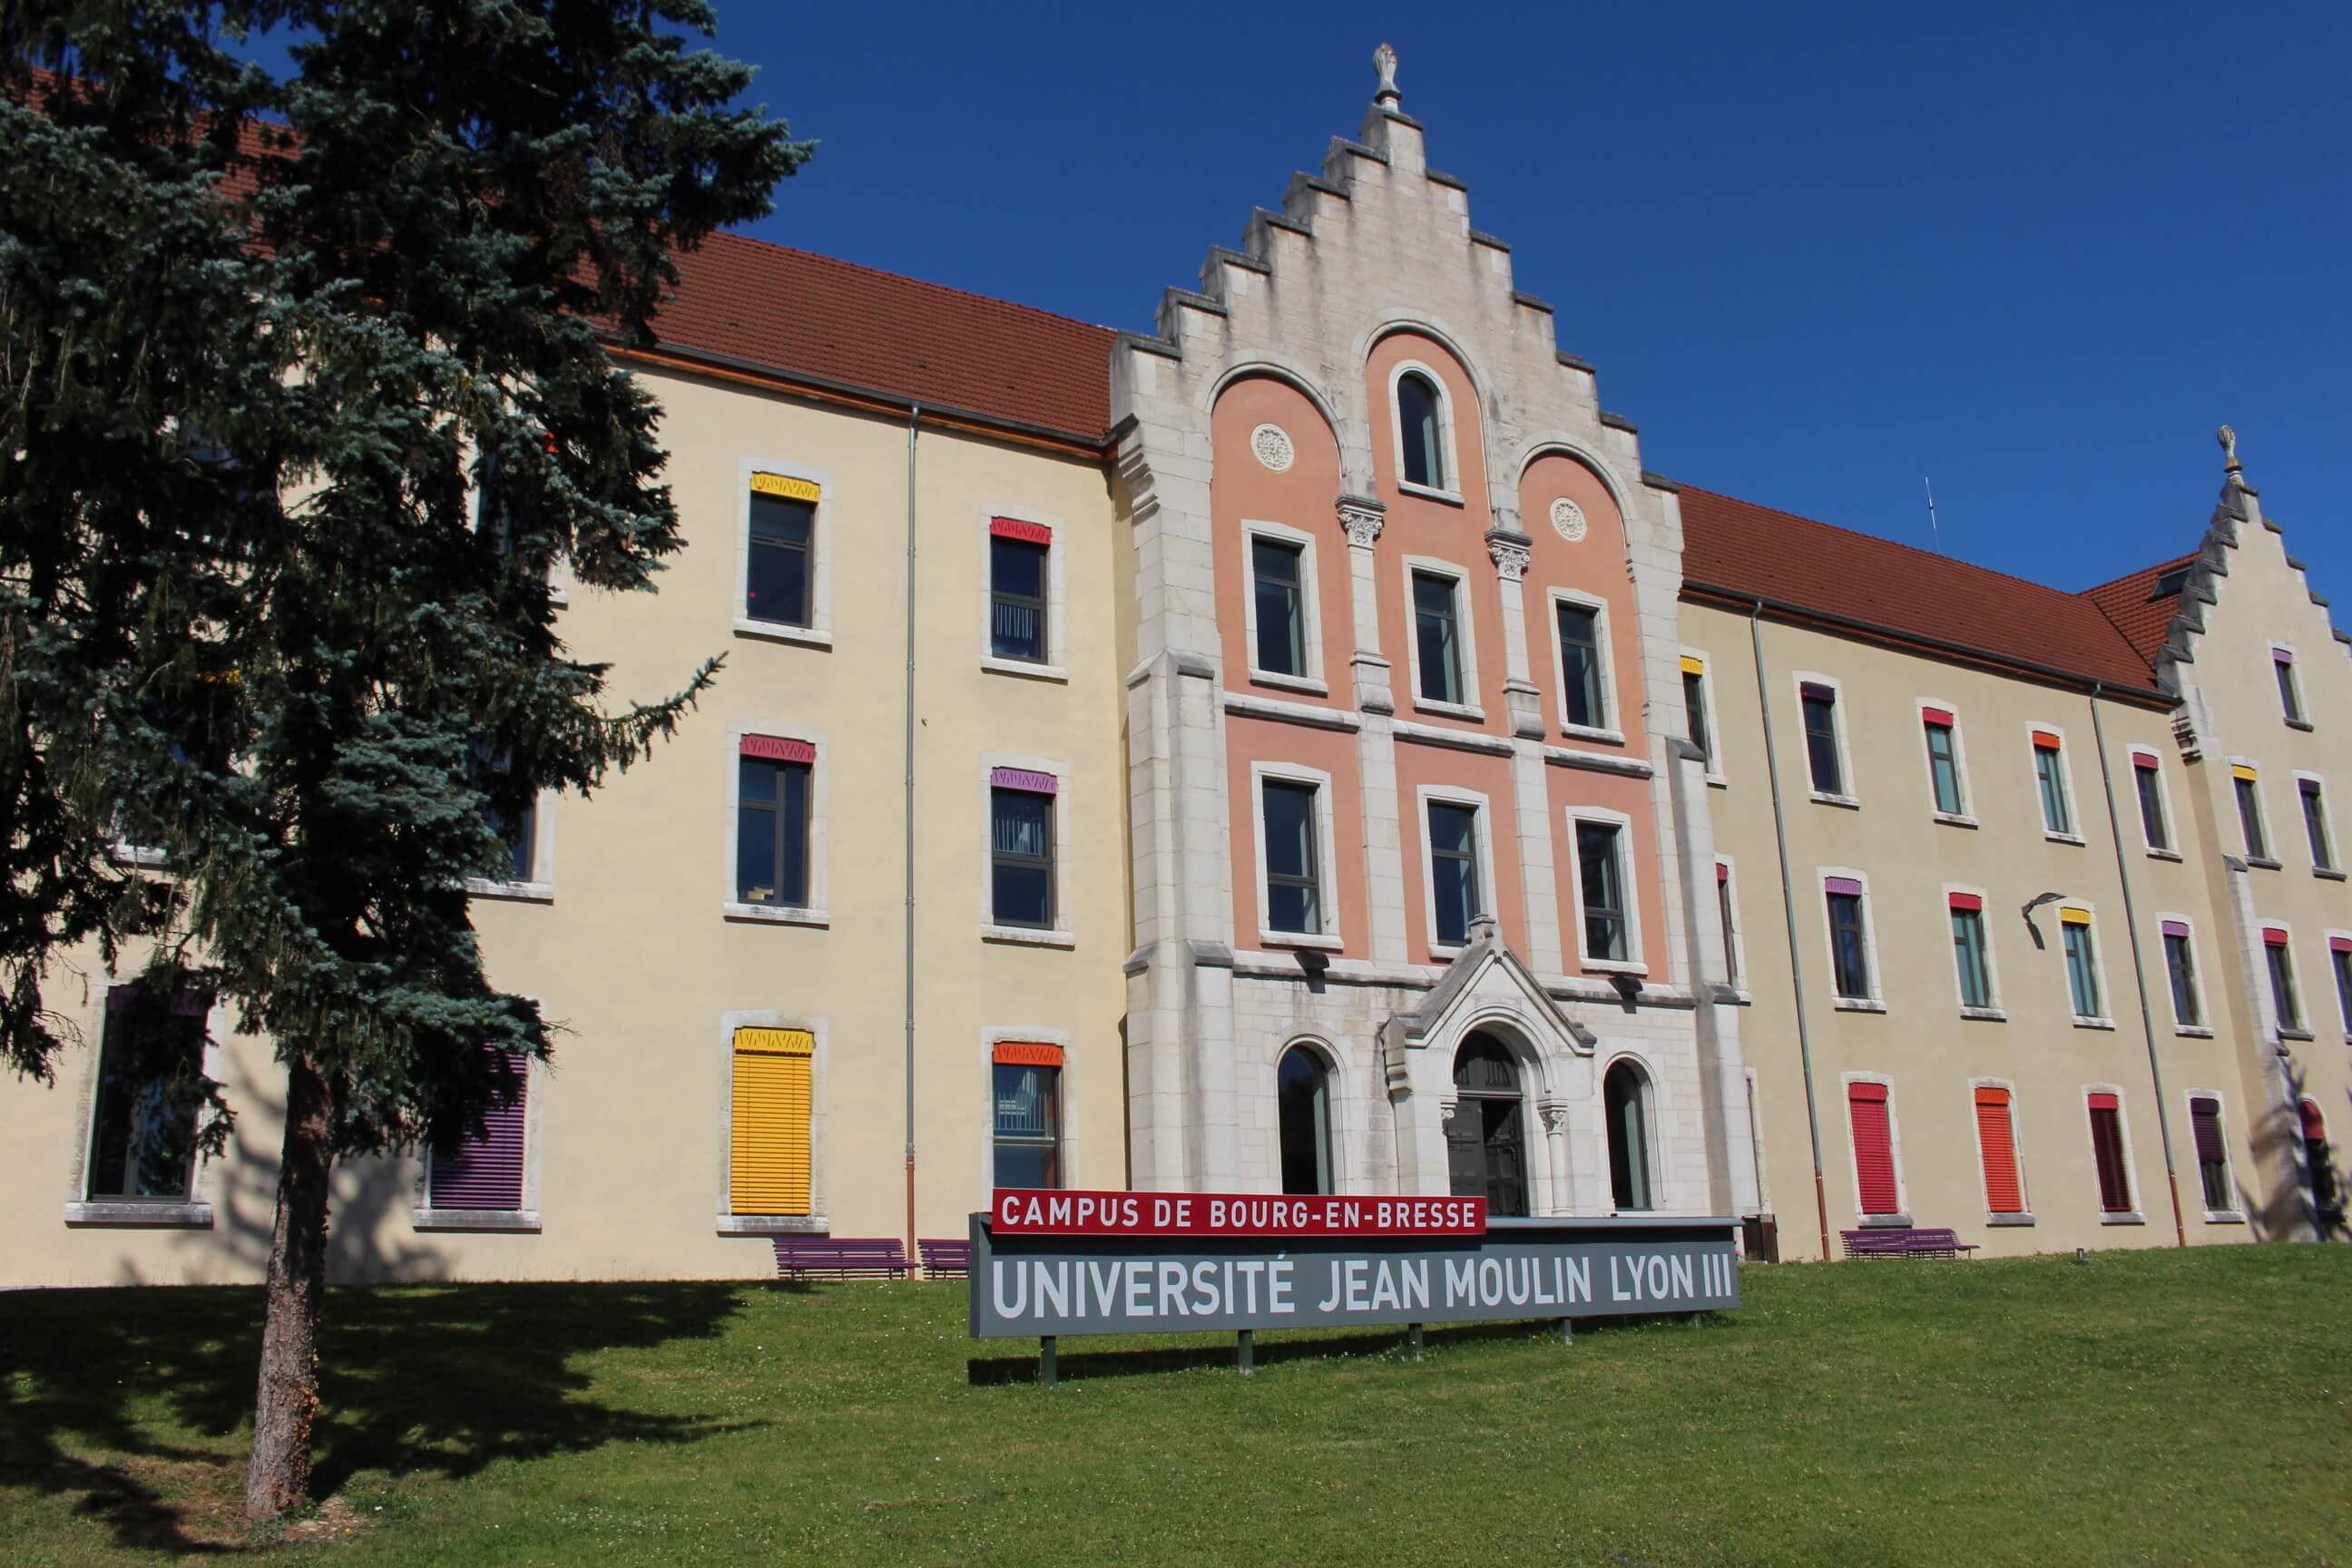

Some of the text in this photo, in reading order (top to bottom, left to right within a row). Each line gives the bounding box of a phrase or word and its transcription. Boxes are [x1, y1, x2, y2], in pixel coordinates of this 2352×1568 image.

[1002, 1196, 1475, 1228] CAMPUS DE BOURG-EN-BRESSE
[993, 1251, 1732, 1318] UNIVERSITÉ JEAN MOULIN LYON III
